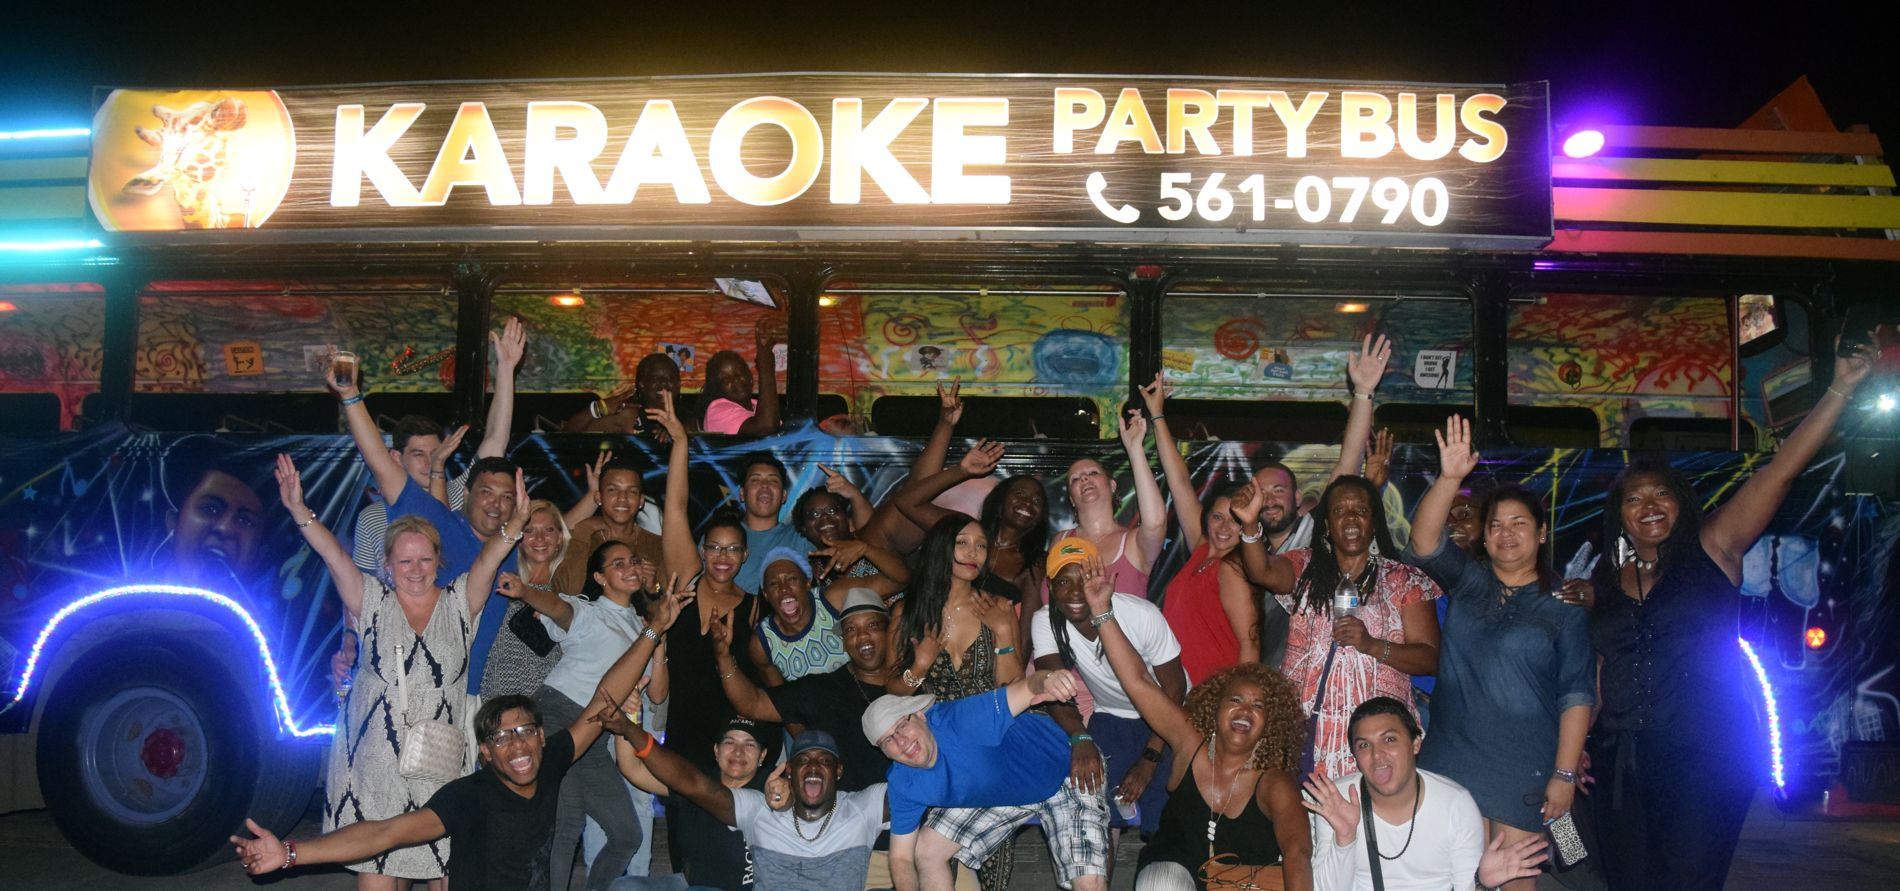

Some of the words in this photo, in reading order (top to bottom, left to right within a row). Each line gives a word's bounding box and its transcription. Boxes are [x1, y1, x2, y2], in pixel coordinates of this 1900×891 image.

[329, 96, 1011, 207] KARAOKE
[1053, 87, 1330, 158] PARTY
[1340, 92, 1509, 164] BUS
[1157, 171, 1450, 227] 561-0790
